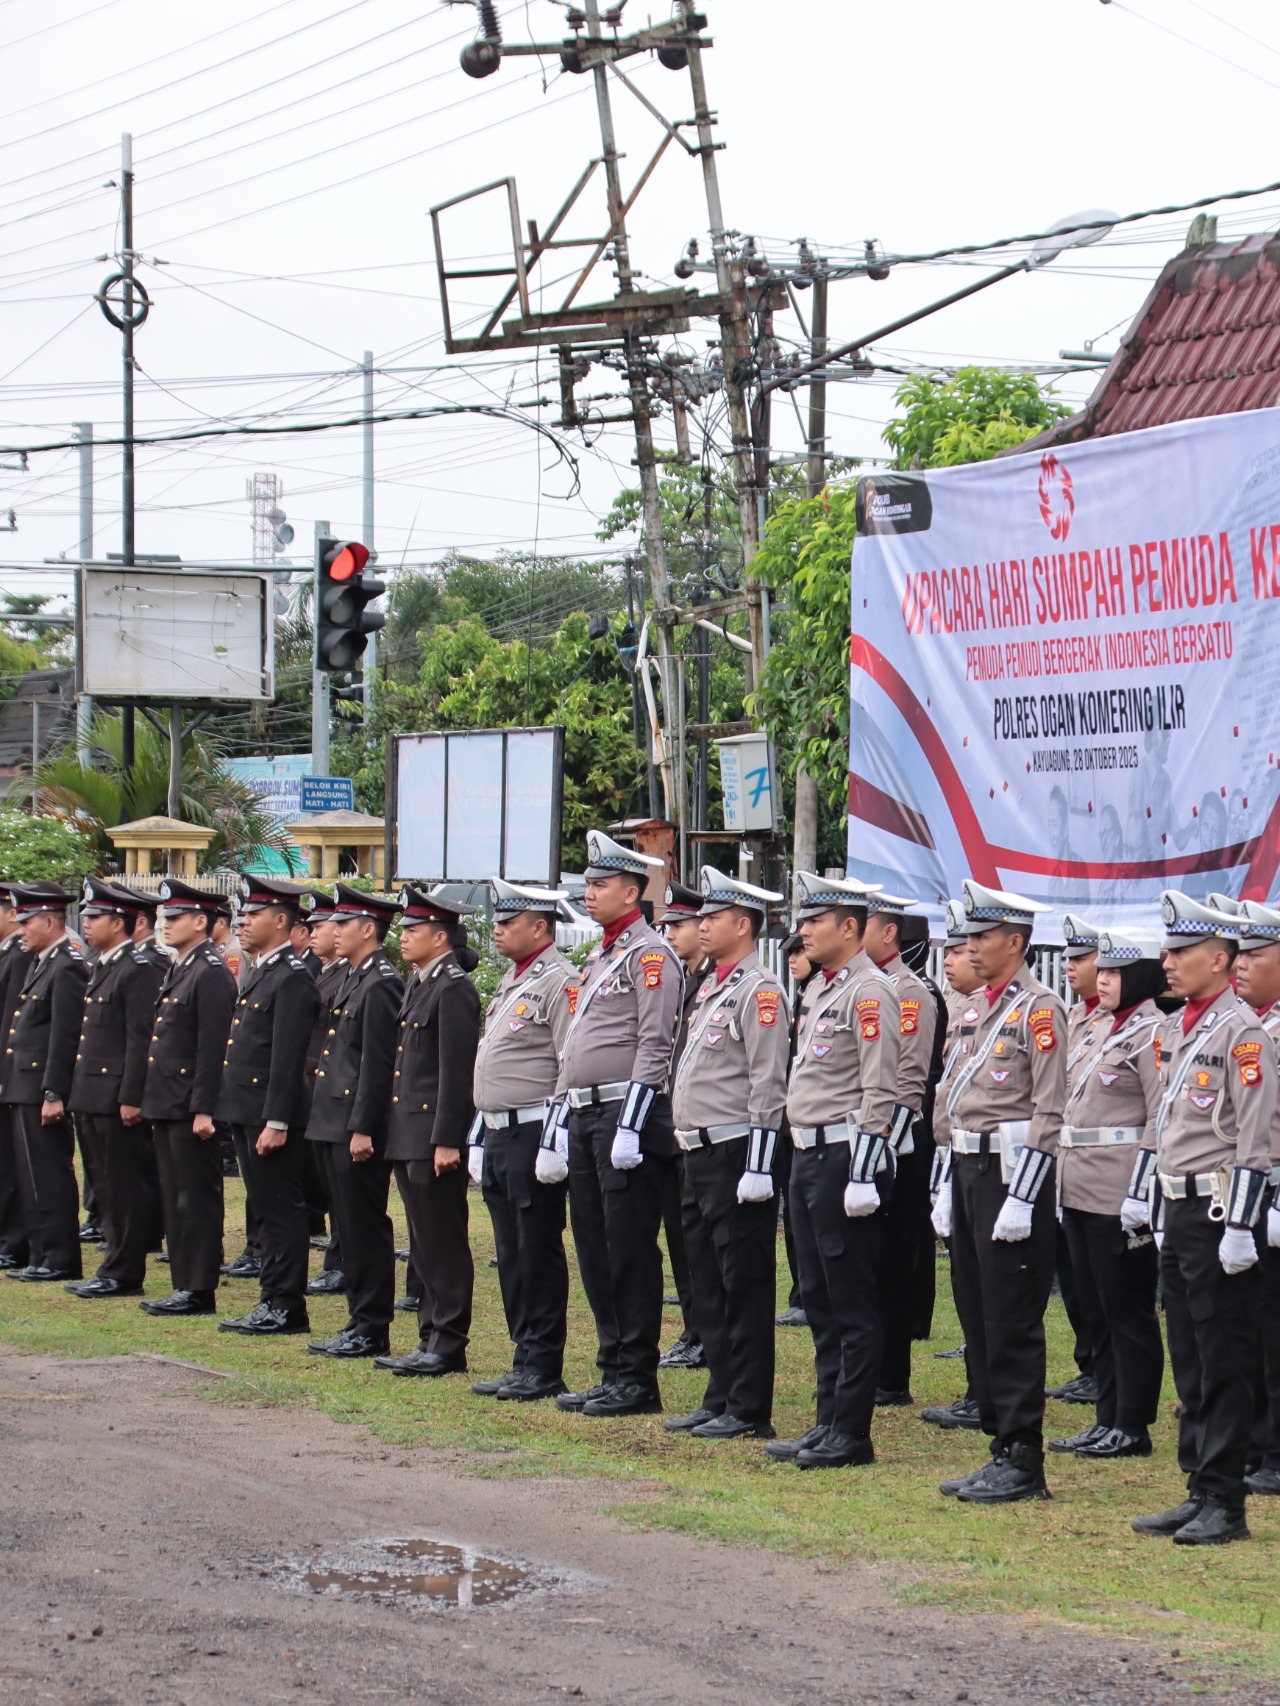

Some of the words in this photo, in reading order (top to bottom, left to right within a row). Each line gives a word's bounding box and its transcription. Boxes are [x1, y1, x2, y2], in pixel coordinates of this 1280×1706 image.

[902, 565, 987, 635] UPACARA
[986, 559, 1031, 628] HARI
[1032, 547, 1126, 624] SUMPAH
[1129, 532, 1238, 613] PEMUDA
[966, 644, 1004, 681] PEMUDA
[1005, 640, 1042, 679] PEMUDI
[1042, 635, 1103, 675] BERGERAK
[1104, 628, 1171, 671] INDONESIA
[1173, 621, 1233, 664] BERSATU
[994, 696, 1039, 740] POLRES
[1040, 693, 1076, 738] OGAN
[1077, 687, 1154, 736] KOMERING
[1156, 684, 1186, 731] ILIR
[1032, 747, 1073, 774] KAYUAGUNG,
[1074, 748, 1083, 771] 28
[1084, 746, 1117, 770] OKTOBER
[1118, 745, 1139, 769] 2025
[304, 782, 331, 790] BELOK
[333, 782, 350, 790] KIRI
[305, 791, 348, 799] LANGSUNG
[744, 766, 771, 808] 7
[305, 799, 324, 807] HATI
[330, 800, 349, 808] HATI
[1192, 1055, 1223, 1068] POLRI
